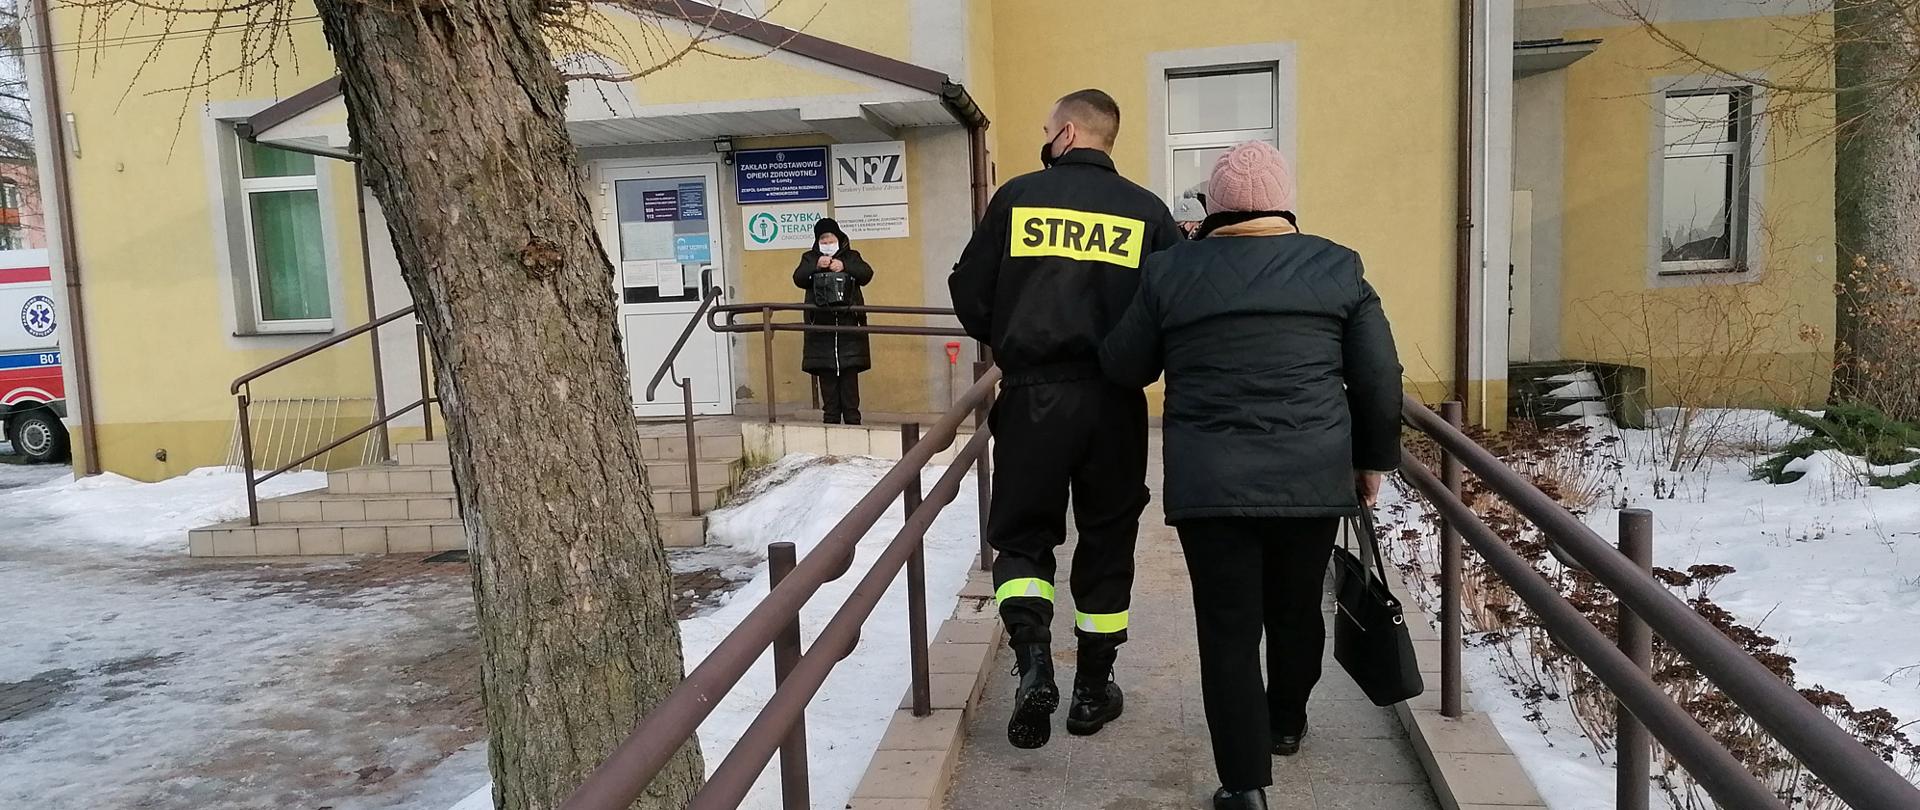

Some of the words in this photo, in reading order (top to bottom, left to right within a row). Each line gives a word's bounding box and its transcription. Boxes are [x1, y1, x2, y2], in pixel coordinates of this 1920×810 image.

[769, 161, 822, 169] PODSTAWOWEJ
[836, 154, 903, 185] NFZ
[770, 170, 817, 178] ZDROWOTNEJ
[781, 212, 821, 222] SZYBKA
